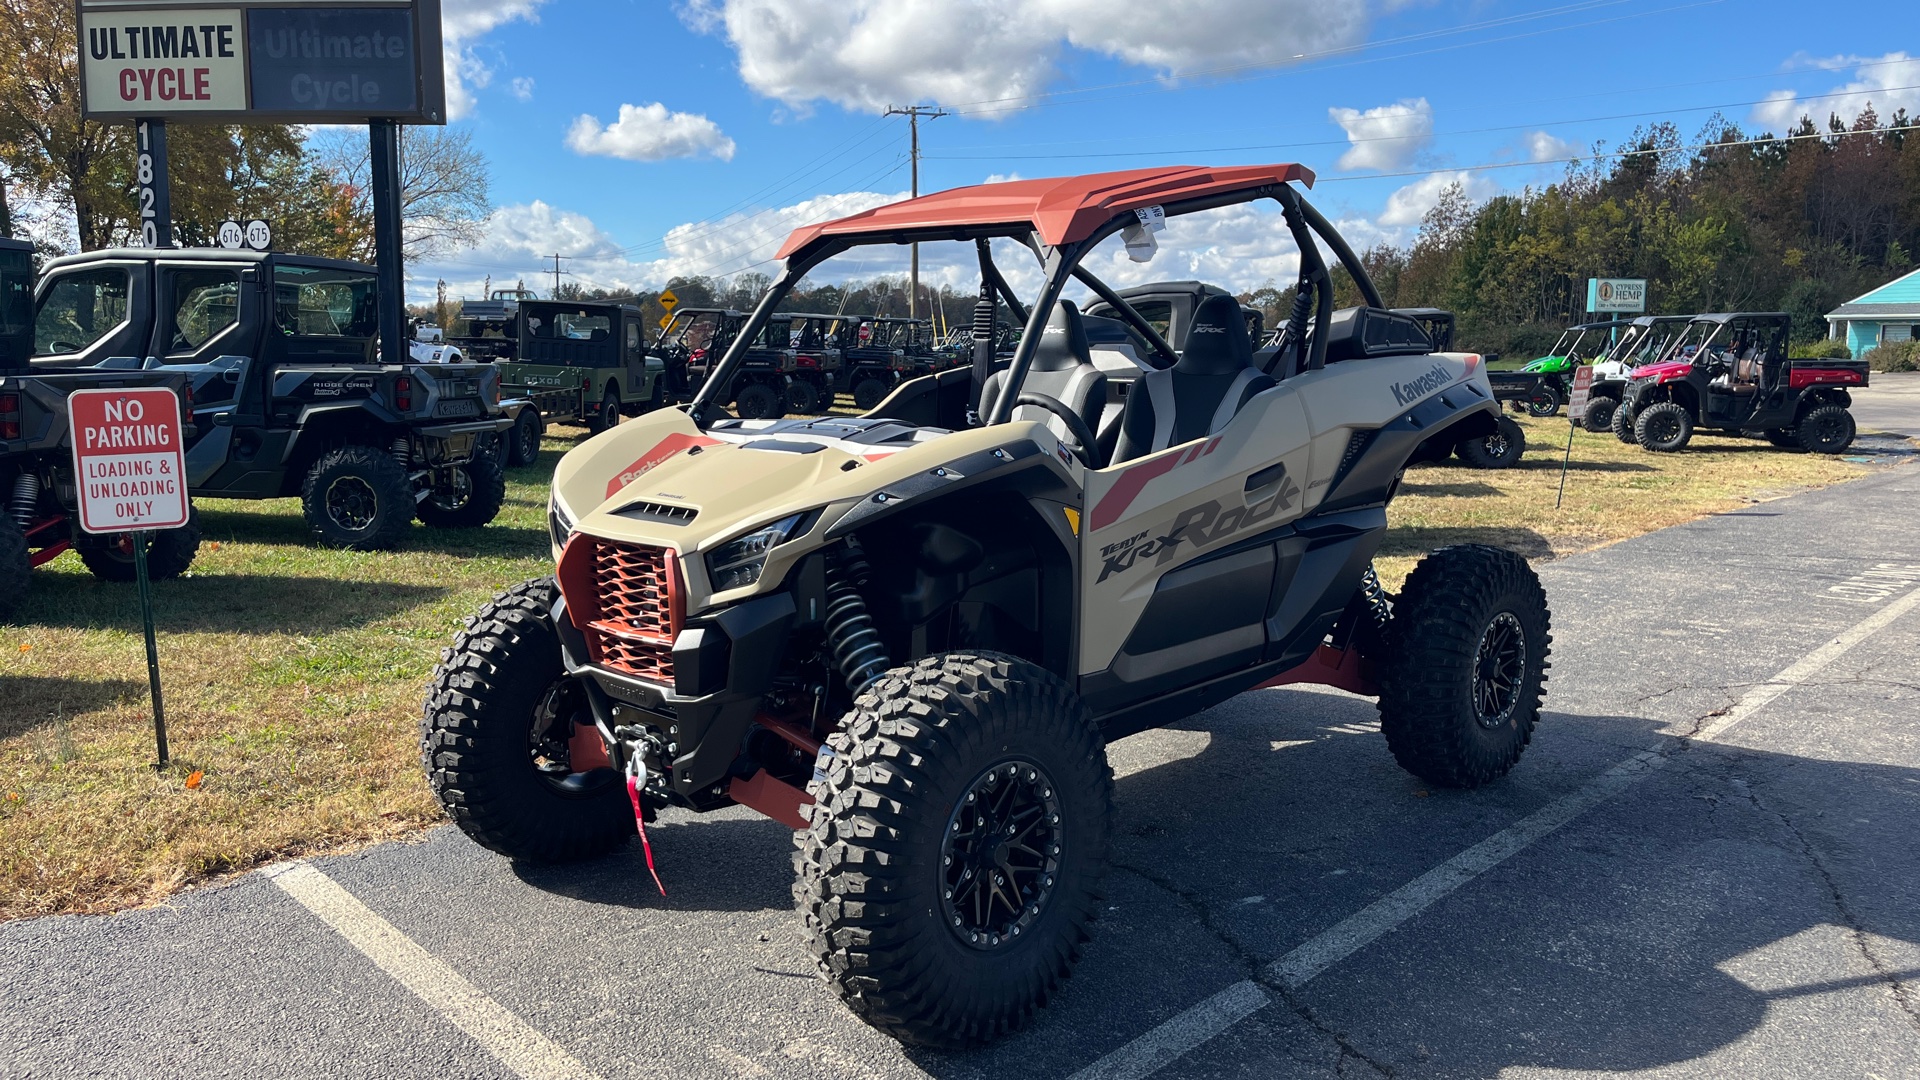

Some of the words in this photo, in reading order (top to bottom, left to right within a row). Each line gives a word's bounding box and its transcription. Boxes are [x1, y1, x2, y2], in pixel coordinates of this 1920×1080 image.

[89, 25, 235, 60] ULTIMATE
[264, 28, 405, 59] Ultimate
[119, 68, 211, 101] CYCLE
[290, 73, 380, 109] Cycle
[138, 121, 158, 248] 1820
[222, 229, 240, 243] 676
[250, 227, 268, 242] 675
[1615, 290, 1642, 300] HEMP
[524, 376, 561, 385] ROXOR
[1389, 363, 1453, 407] Kawasaki
[104, 399, 144, 422] NO
[438, 401, 474, 416] Kawasaki
[84, 424, 170, 449] PARKING
[89, 460, 153, 478] LOADING
[159, 459, 171, 474] &
[618, 460, 657, 486] Rock
[90, 480, 175, 499] UNLOADING
[115, 501, 153, 518] ONLY
[1095, 525, 1188, 585] KRX
